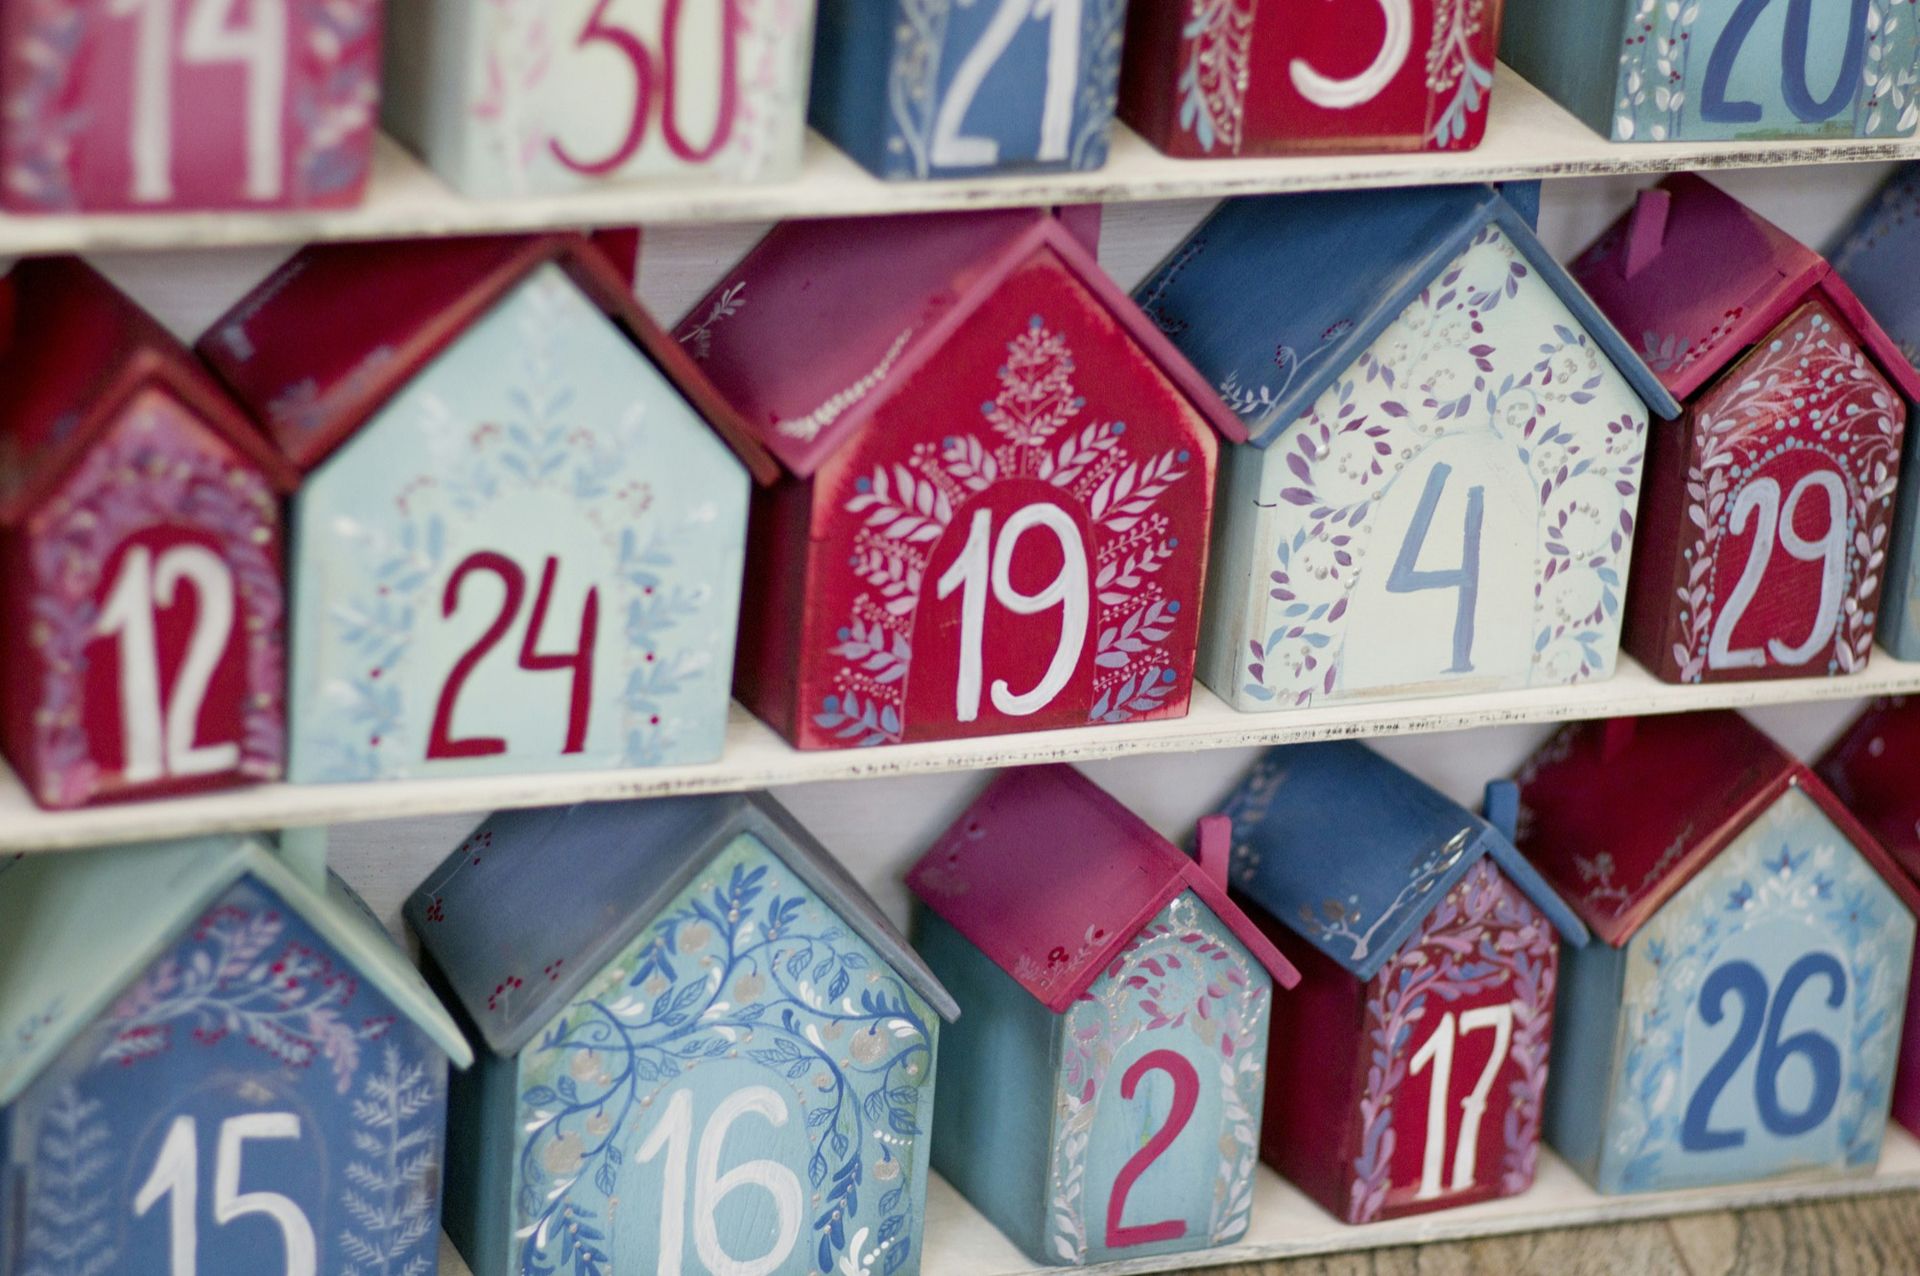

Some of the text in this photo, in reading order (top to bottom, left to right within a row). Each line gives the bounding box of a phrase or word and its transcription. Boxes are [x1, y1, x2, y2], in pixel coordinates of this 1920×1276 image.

[103, 0, 288, 202] 14
[548, 0, 738, 176] 30
[930, 0, 1081, 167] 21
[1700, 0, 1870, 124] 20
[93, 543, 241, 783] 12
[425, 551, 599, 761] 24
[937, 502, 1090, 721] 19
[1387, 462, 1484, 673] 4
[1708, 470, 1848, 669] 29
[1105, 1048, 1199, 1247] 2
[1409, 1003, 1513, 1199] 17
[1680, 951, 1847, 1153] 26
[134, 1112, 317, 1276] 15
[636, 1085, 803, 1276] 16
